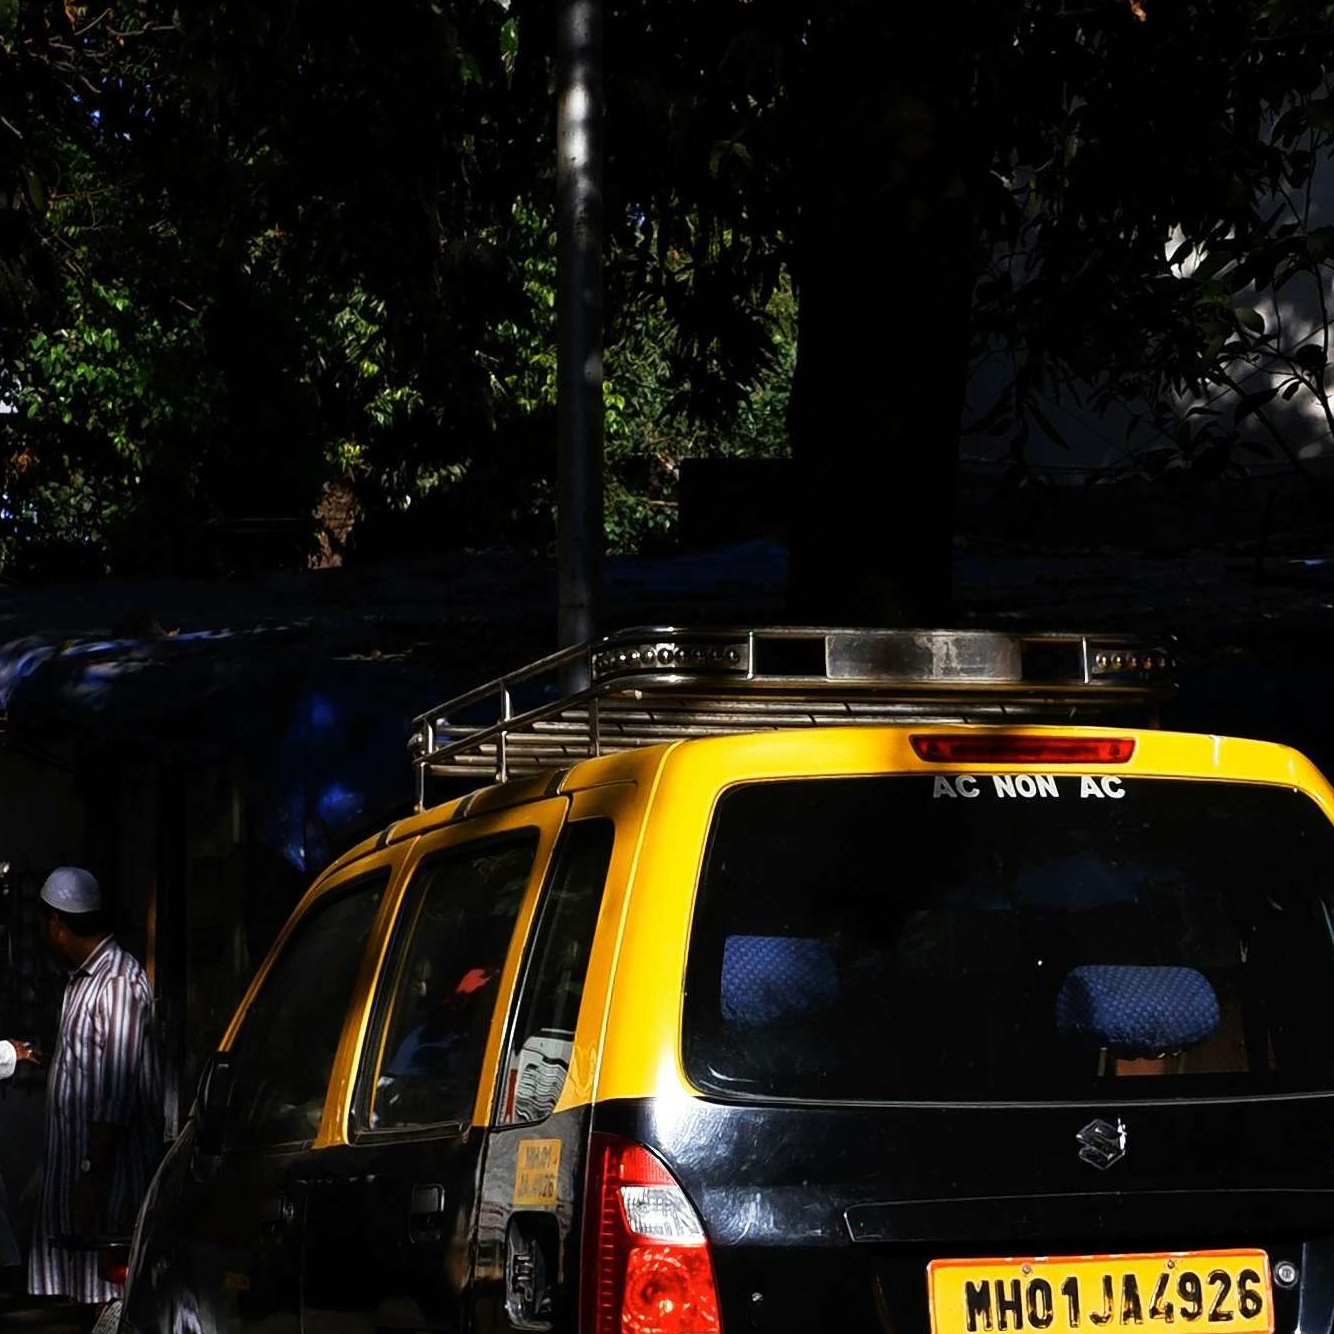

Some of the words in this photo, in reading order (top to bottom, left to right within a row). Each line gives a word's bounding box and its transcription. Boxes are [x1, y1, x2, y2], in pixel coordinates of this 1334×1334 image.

[932, 774, 981, 799] AC
[992, 774, 1060, 799] NON
[1079, 774, 1127, 799] AC
[964, 1268, 1264, 1333] MH01JA4926
